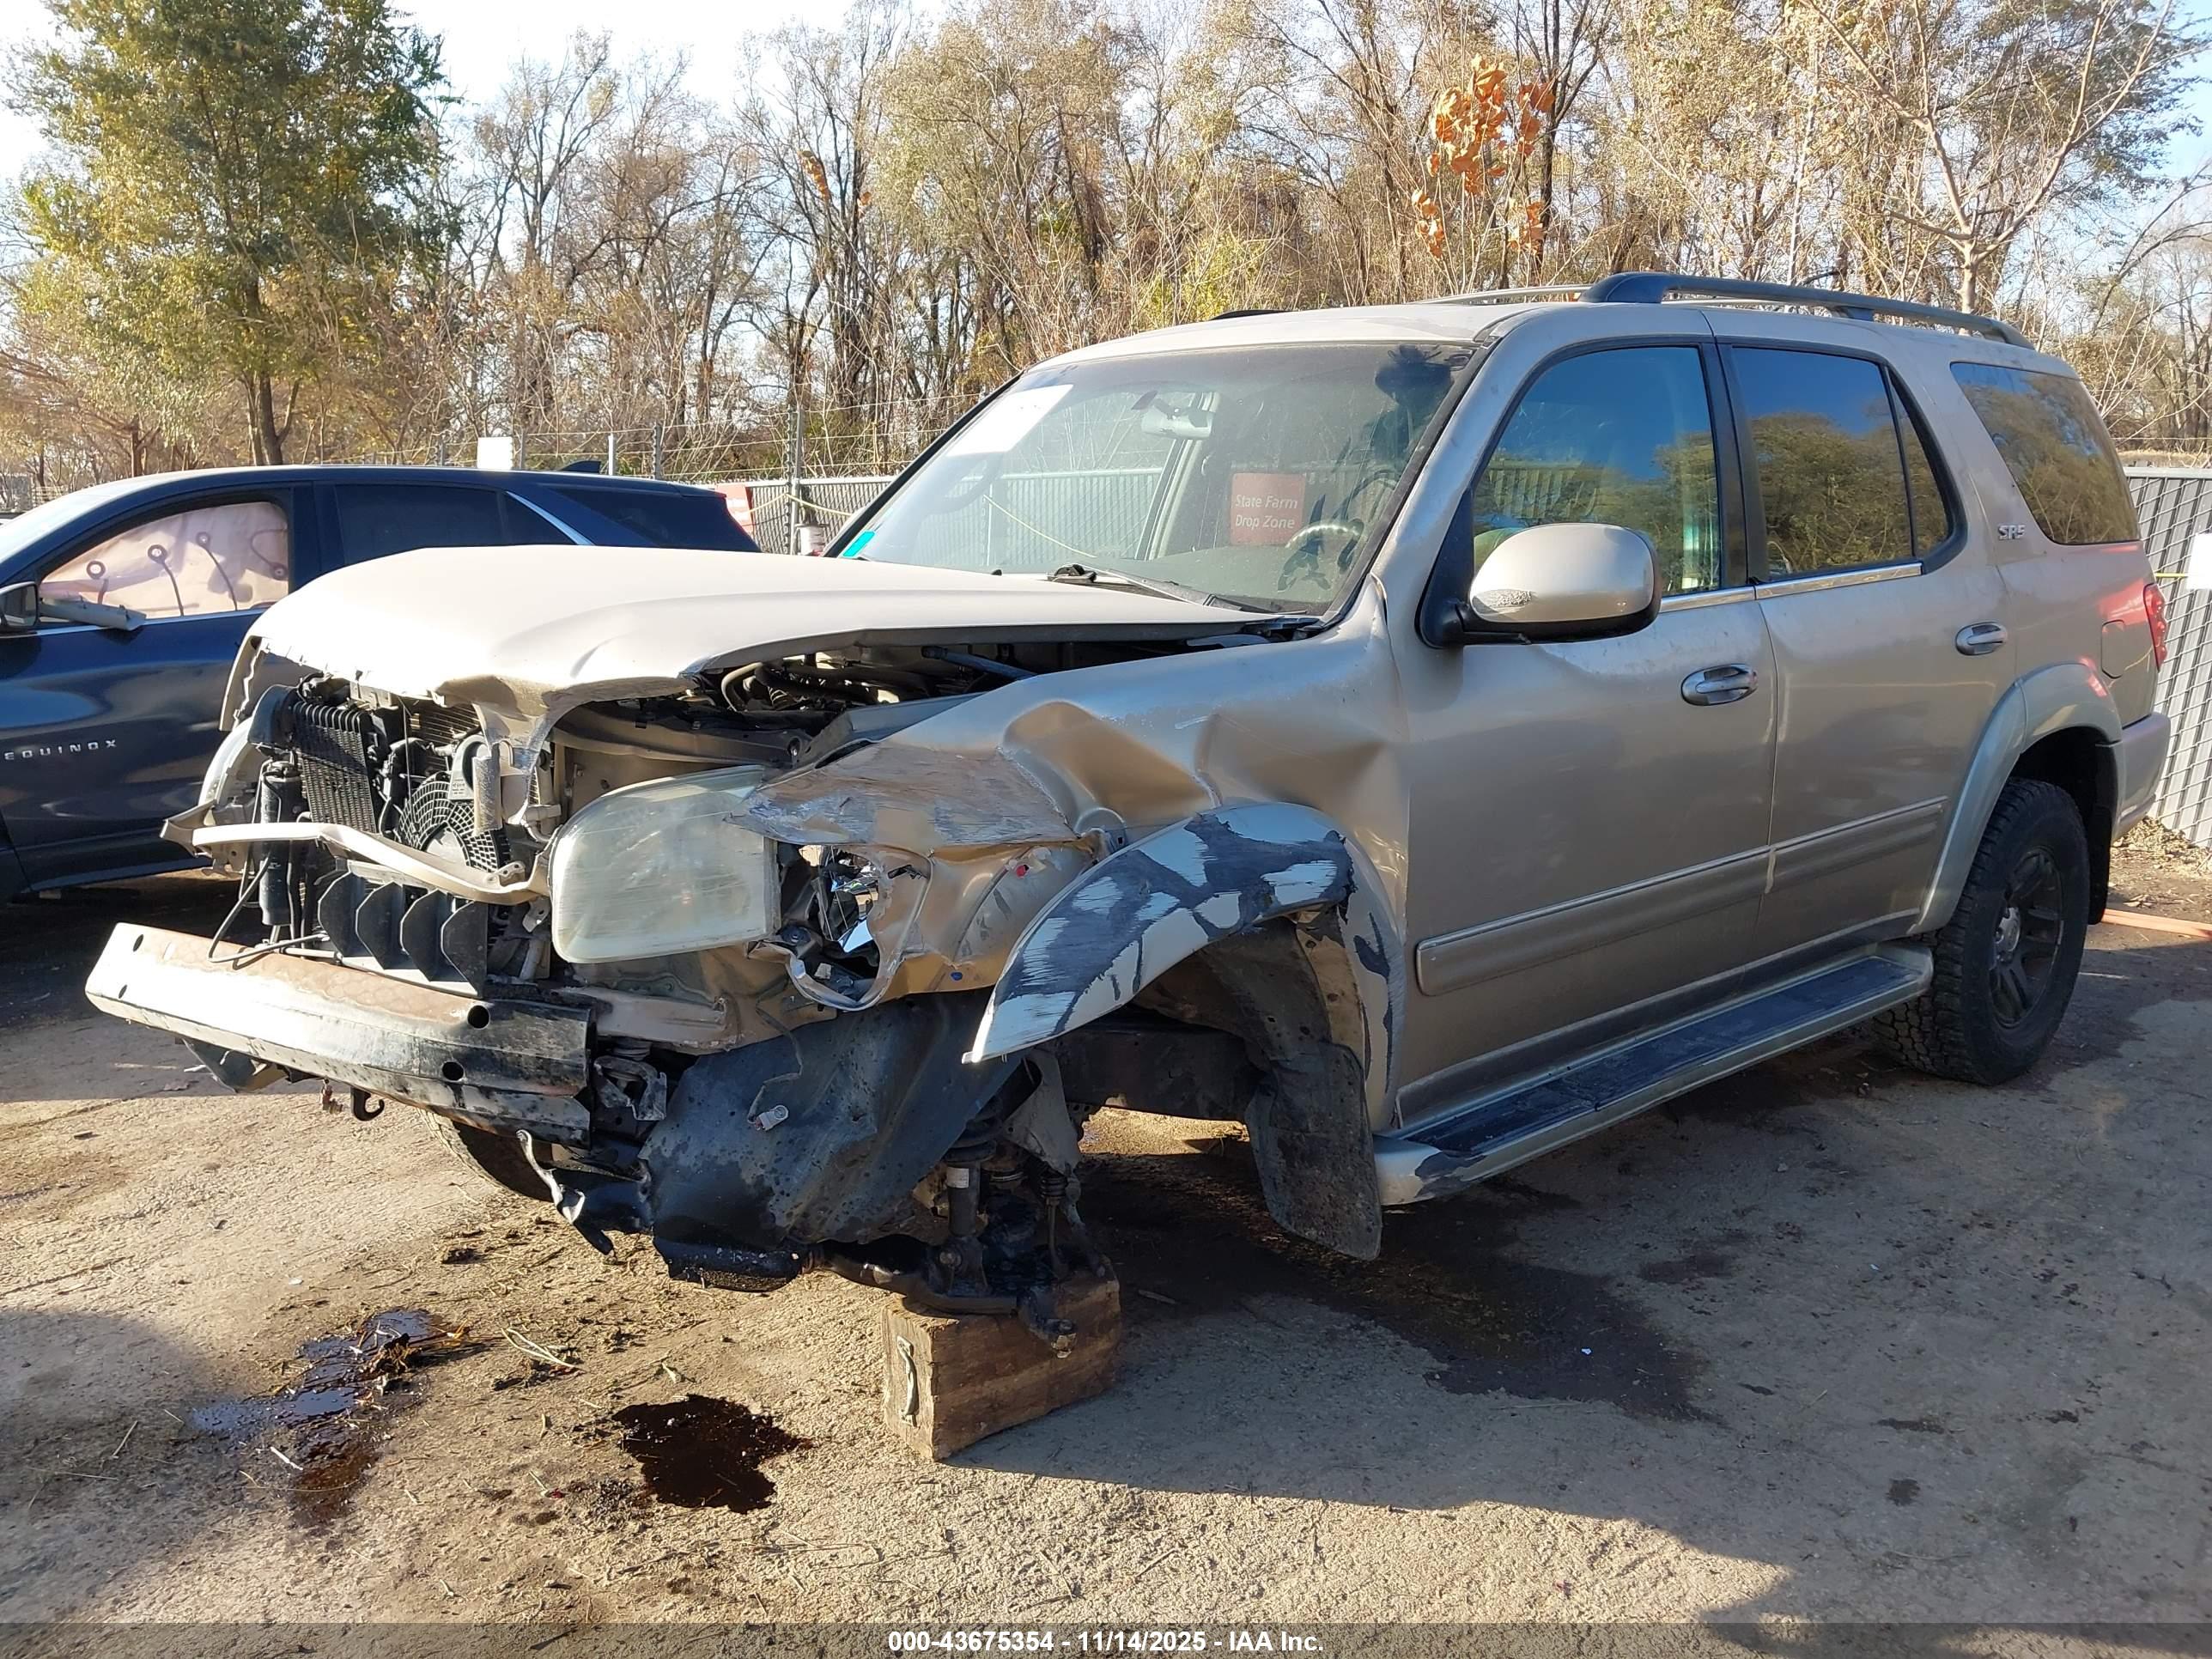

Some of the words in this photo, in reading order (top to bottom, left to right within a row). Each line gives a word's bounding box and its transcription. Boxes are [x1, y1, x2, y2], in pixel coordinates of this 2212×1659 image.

[1235, 494, 1262, 508] State
[1264, 495, 1298, 509] Farm
[1235, 514, 1260, 530] Drop
[1262, 515, 1296, 529] Zone
[1998, 524, 2027, 540] SR5
[3, 739, 117, 761] EQUINOX
